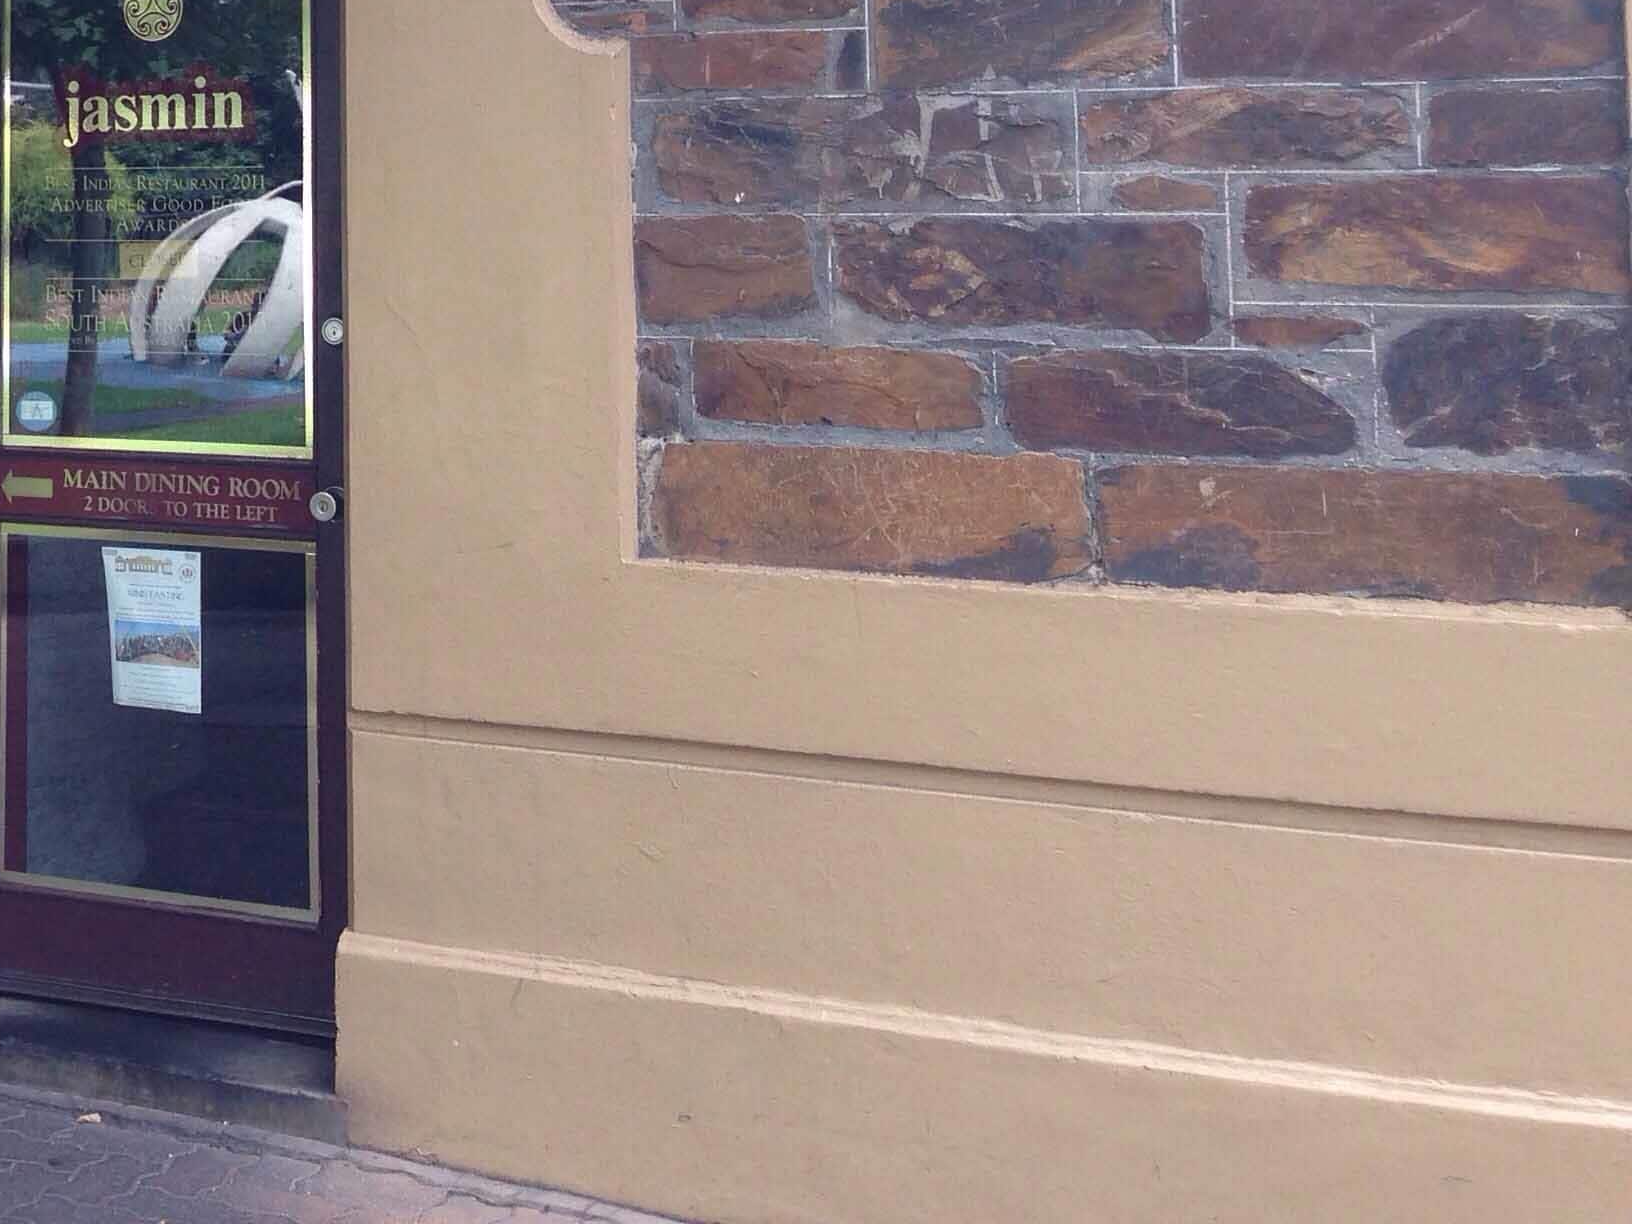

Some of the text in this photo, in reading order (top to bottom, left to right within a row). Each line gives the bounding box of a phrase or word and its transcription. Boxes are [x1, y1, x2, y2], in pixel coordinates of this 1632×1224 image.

[62, 76, 246, 148] jasmin
[62, 468, 302, 501] MAIN DINING ROOM
[83, 495, 94, 512] 2
[162, 500, 188, 518] TO
[191, 501, 231, 520] THE
[235, 504, 279, 523] LEFT
